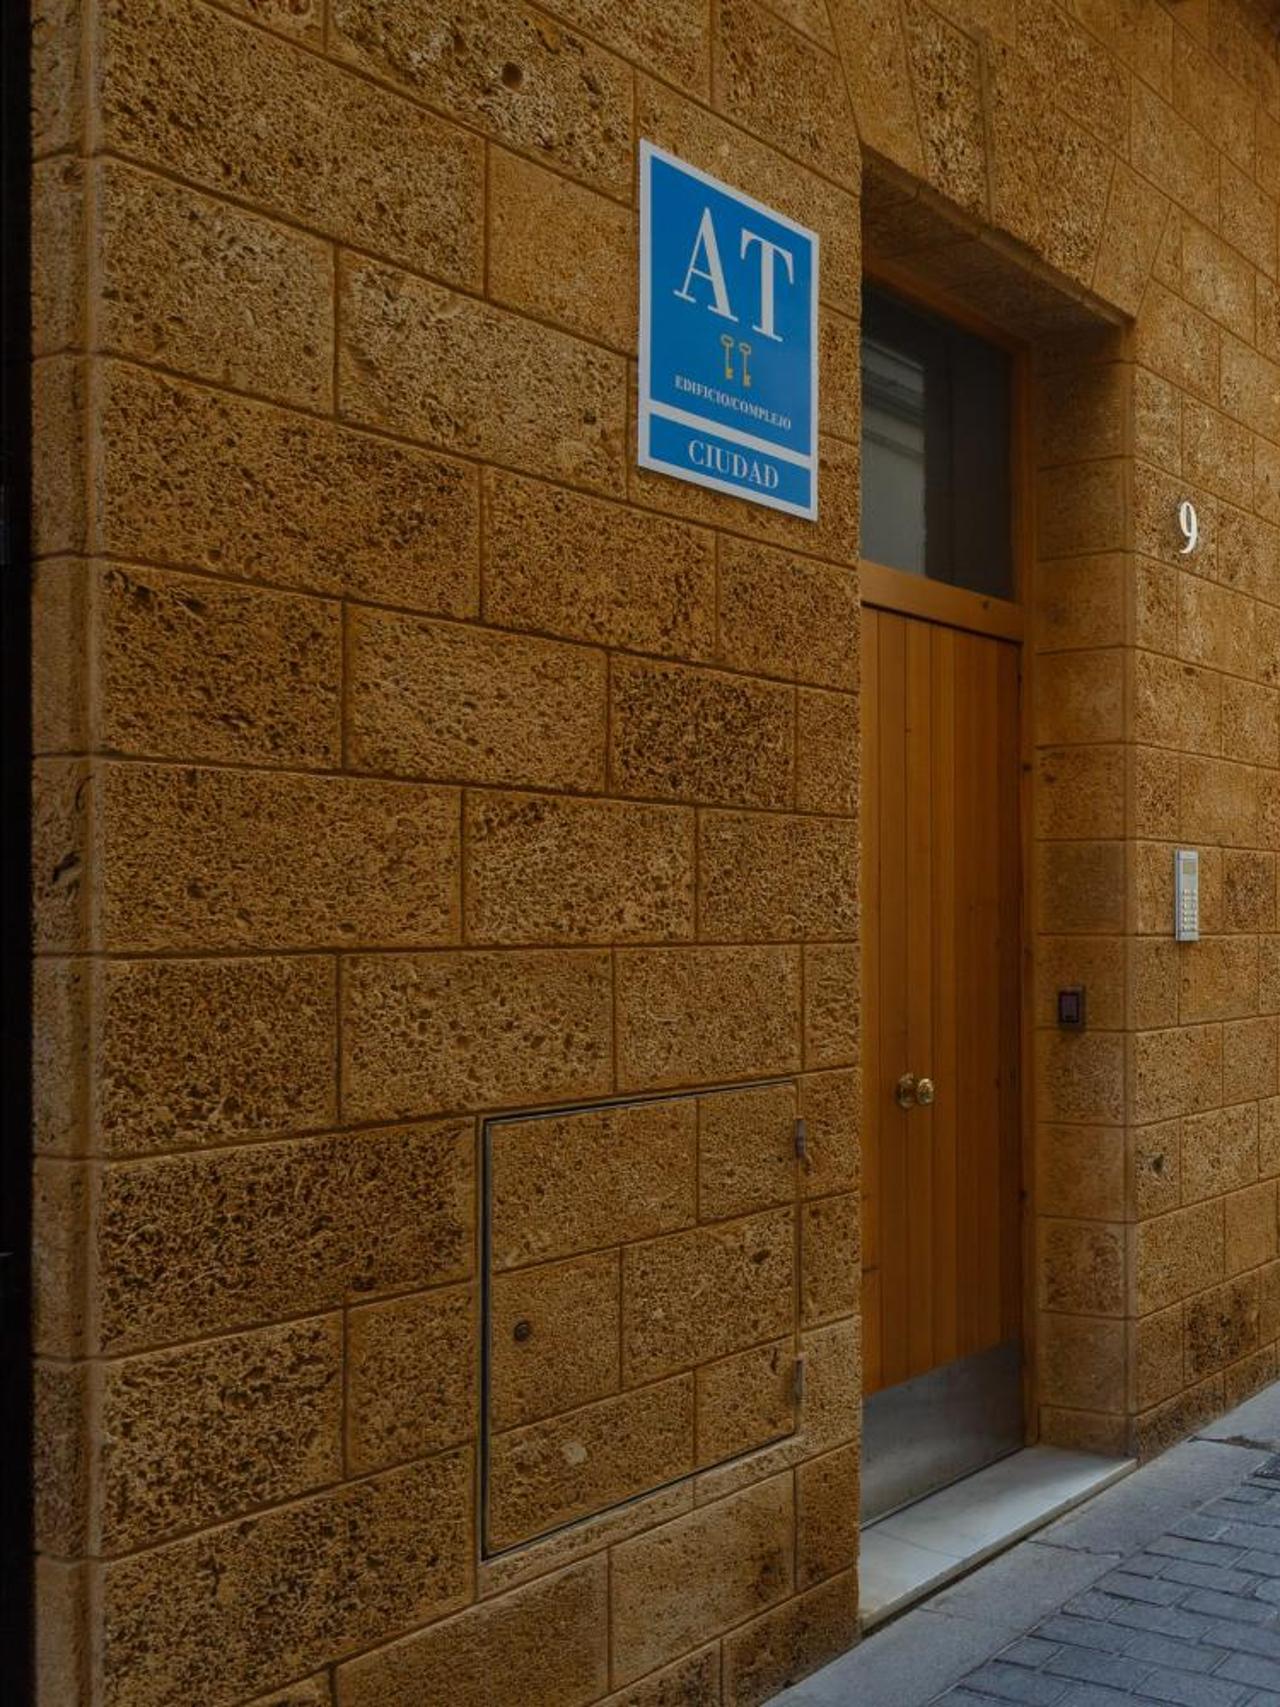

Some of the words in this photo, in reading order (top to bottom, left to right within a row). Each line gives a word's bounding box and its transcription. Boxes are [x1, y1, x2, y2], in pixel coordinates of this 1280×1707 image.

[673, 207, 794, 342] AT
[688, 439, 779, 489] CIUDAD
[1179, 501, 1198, 554] 9
